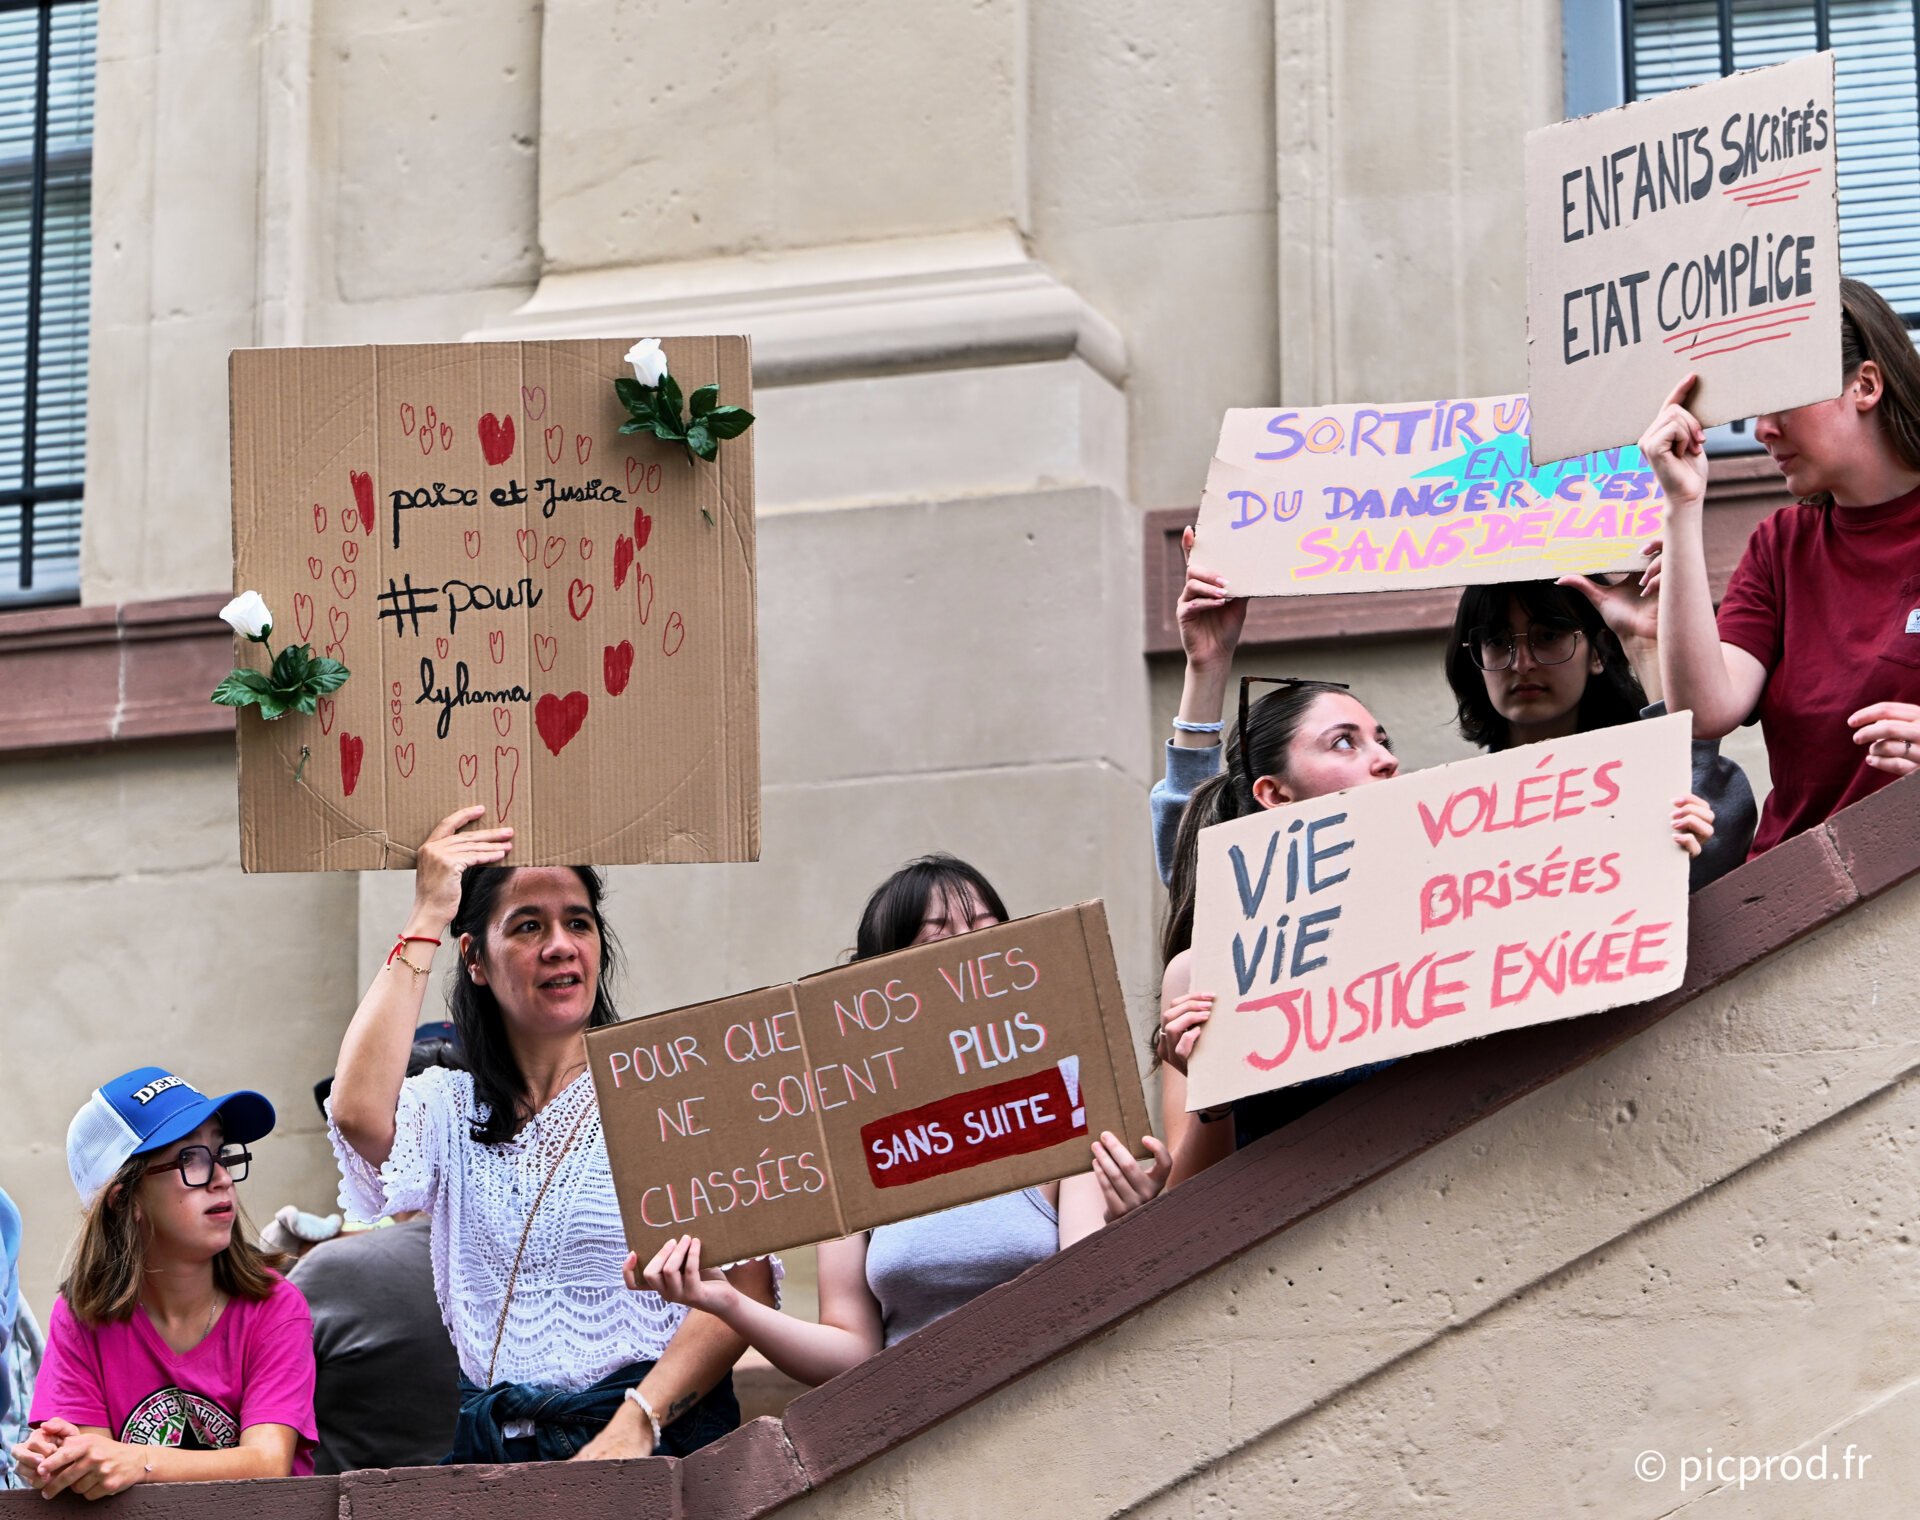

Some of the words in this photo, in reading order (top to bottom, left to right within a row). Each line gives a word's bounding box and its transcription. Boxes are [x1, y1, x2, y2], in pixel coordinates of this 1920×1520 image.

[1563, 127, 1713, 243] ENFANTS
[1564, 270, 1650, 365] ETAT
[1493, 397, 1531, 434] U
[389, 482, 477, 549] paix
[490, 480, 527, 506] et
[1227, 489, 1303, 529] DU
[1555, 471, 1664, 501] C'ES
[1292, 516, 1475, 580] SANS
[1417, 754, 1623, 847] VOLÉES
[609, 1036, 707, 1088] POUR
[725, 1011, 801, 1062] QUE
[834, 979, 922, 1037] NOS
[938, 947, 1040, 1003] VIES
[1235, 951, 1475, 1071] JUSTICE
[657, 1096, 710, 1142] NE
[751, 1047, 904, 1122] SOIENT
[949, 1011, 1048, 1075] PLUS
[641, 1147, 828, 1227] CLASSÉES
[872, 1122, 954, 1170] SANS
